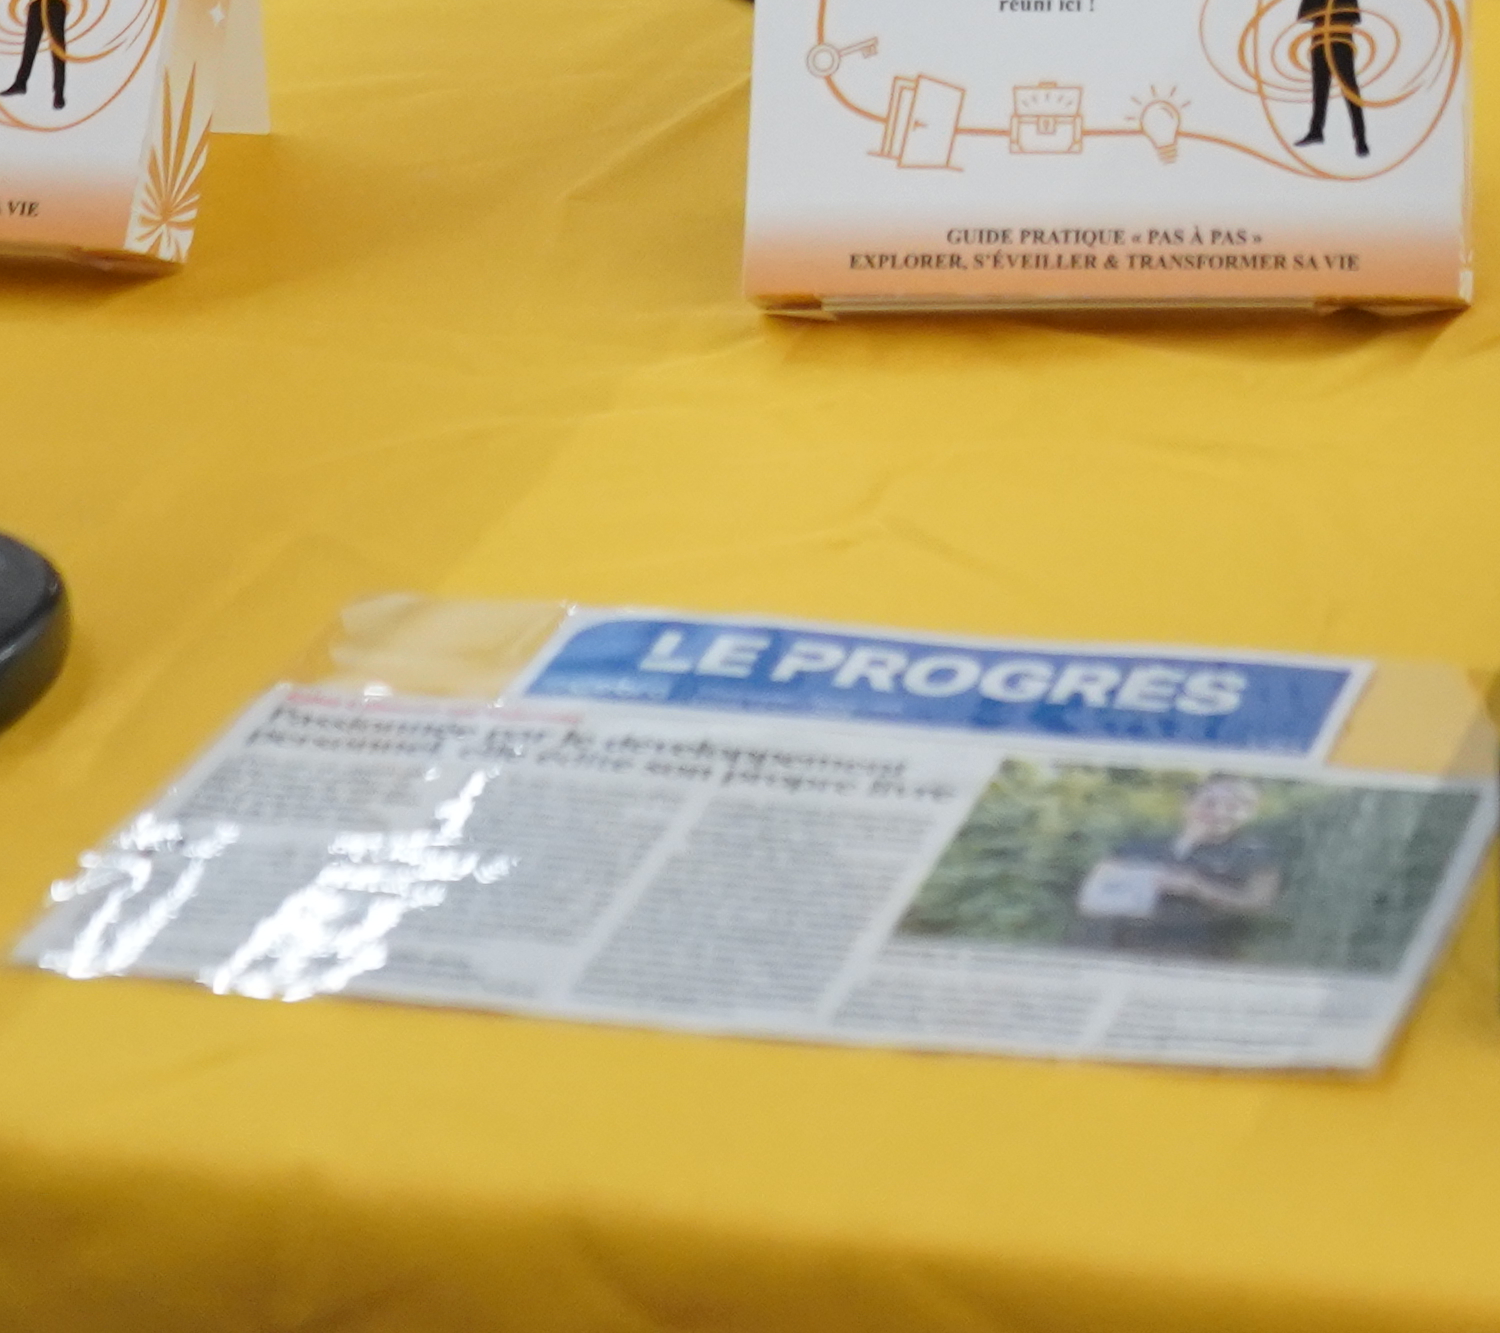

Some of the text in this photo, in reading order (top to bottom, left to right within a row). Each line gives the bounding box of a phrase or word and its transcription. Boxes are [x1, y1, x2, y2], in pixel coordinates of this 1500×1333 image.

[7, 200, 40, 217] VIE
[946, 227, 1014, 246] GUIDE
[1019, 228, 1126, 248] PRATIQUE
[1147, 228, 1185, 246] PAS
[1189, 225, 1204, 246] À
[1209, 229, 1247, 246] PAS
[849, 253, 967, 271] EXPLORER,
[1103, 253, 1120, 270] &
[1126, 253, 1288, 271] TRANSFORMER
[1292, 253, 1318, 271] SA
[1323, 253, 1361, 271] VIE
[639, 629, 771, 678] LE
